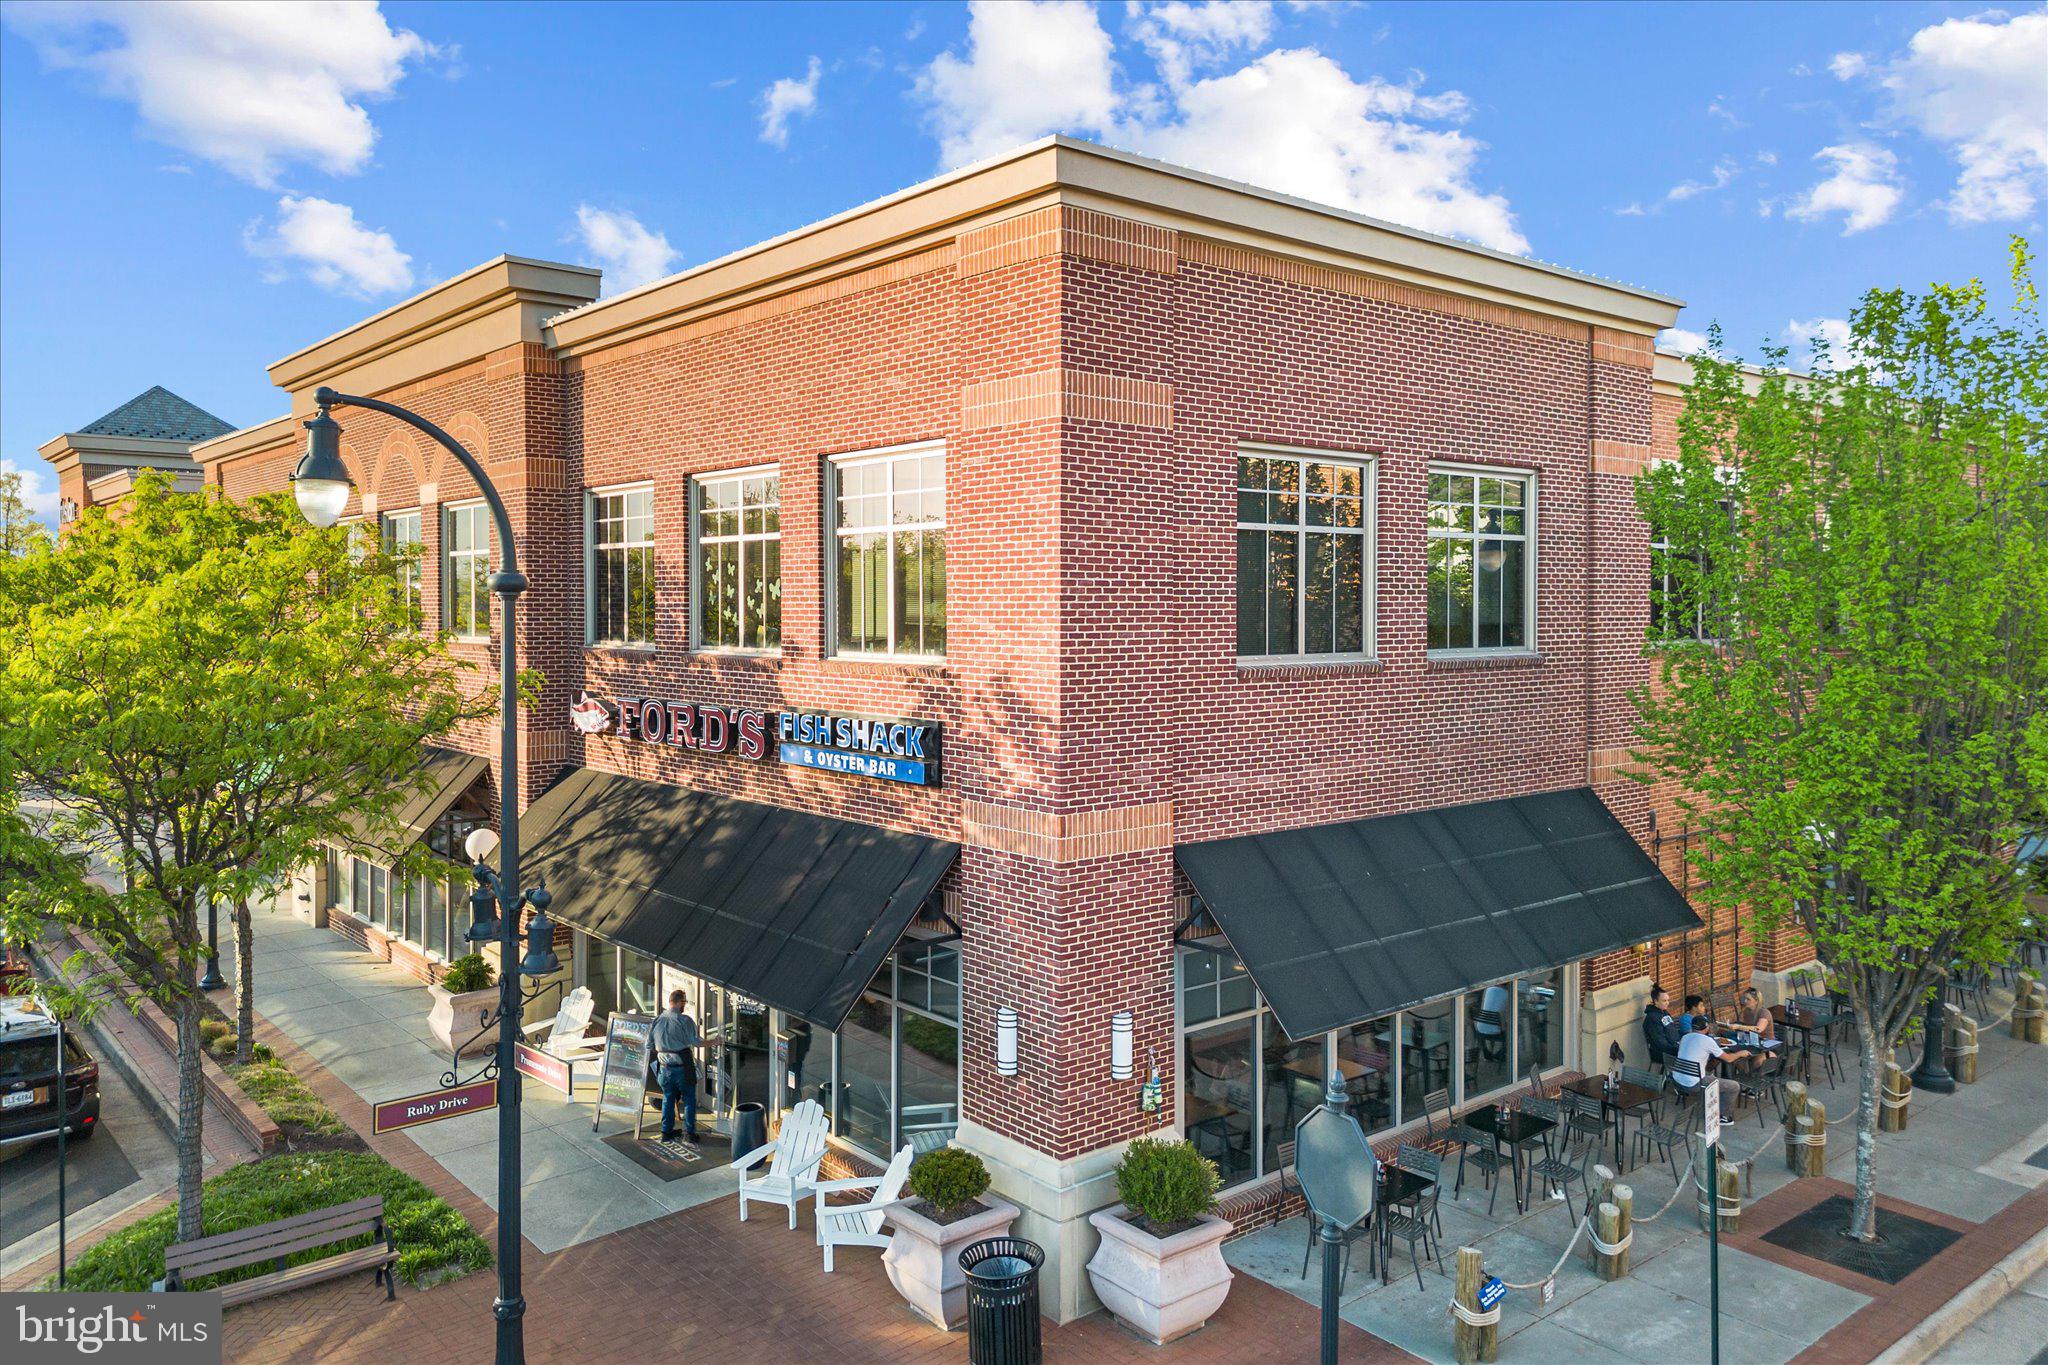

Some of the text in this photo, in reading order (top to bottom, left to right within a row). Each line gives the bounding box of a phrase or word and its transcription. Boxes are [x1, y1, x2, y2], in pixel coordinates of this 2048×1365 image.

[616, 698, 766, 760] FORD'S
[779, 713, 925, 758] FISH SHACK
[803, 750, 896, 776] & OYSTER BAR
[407, 1096, 469, 1117] Ruby Drive
